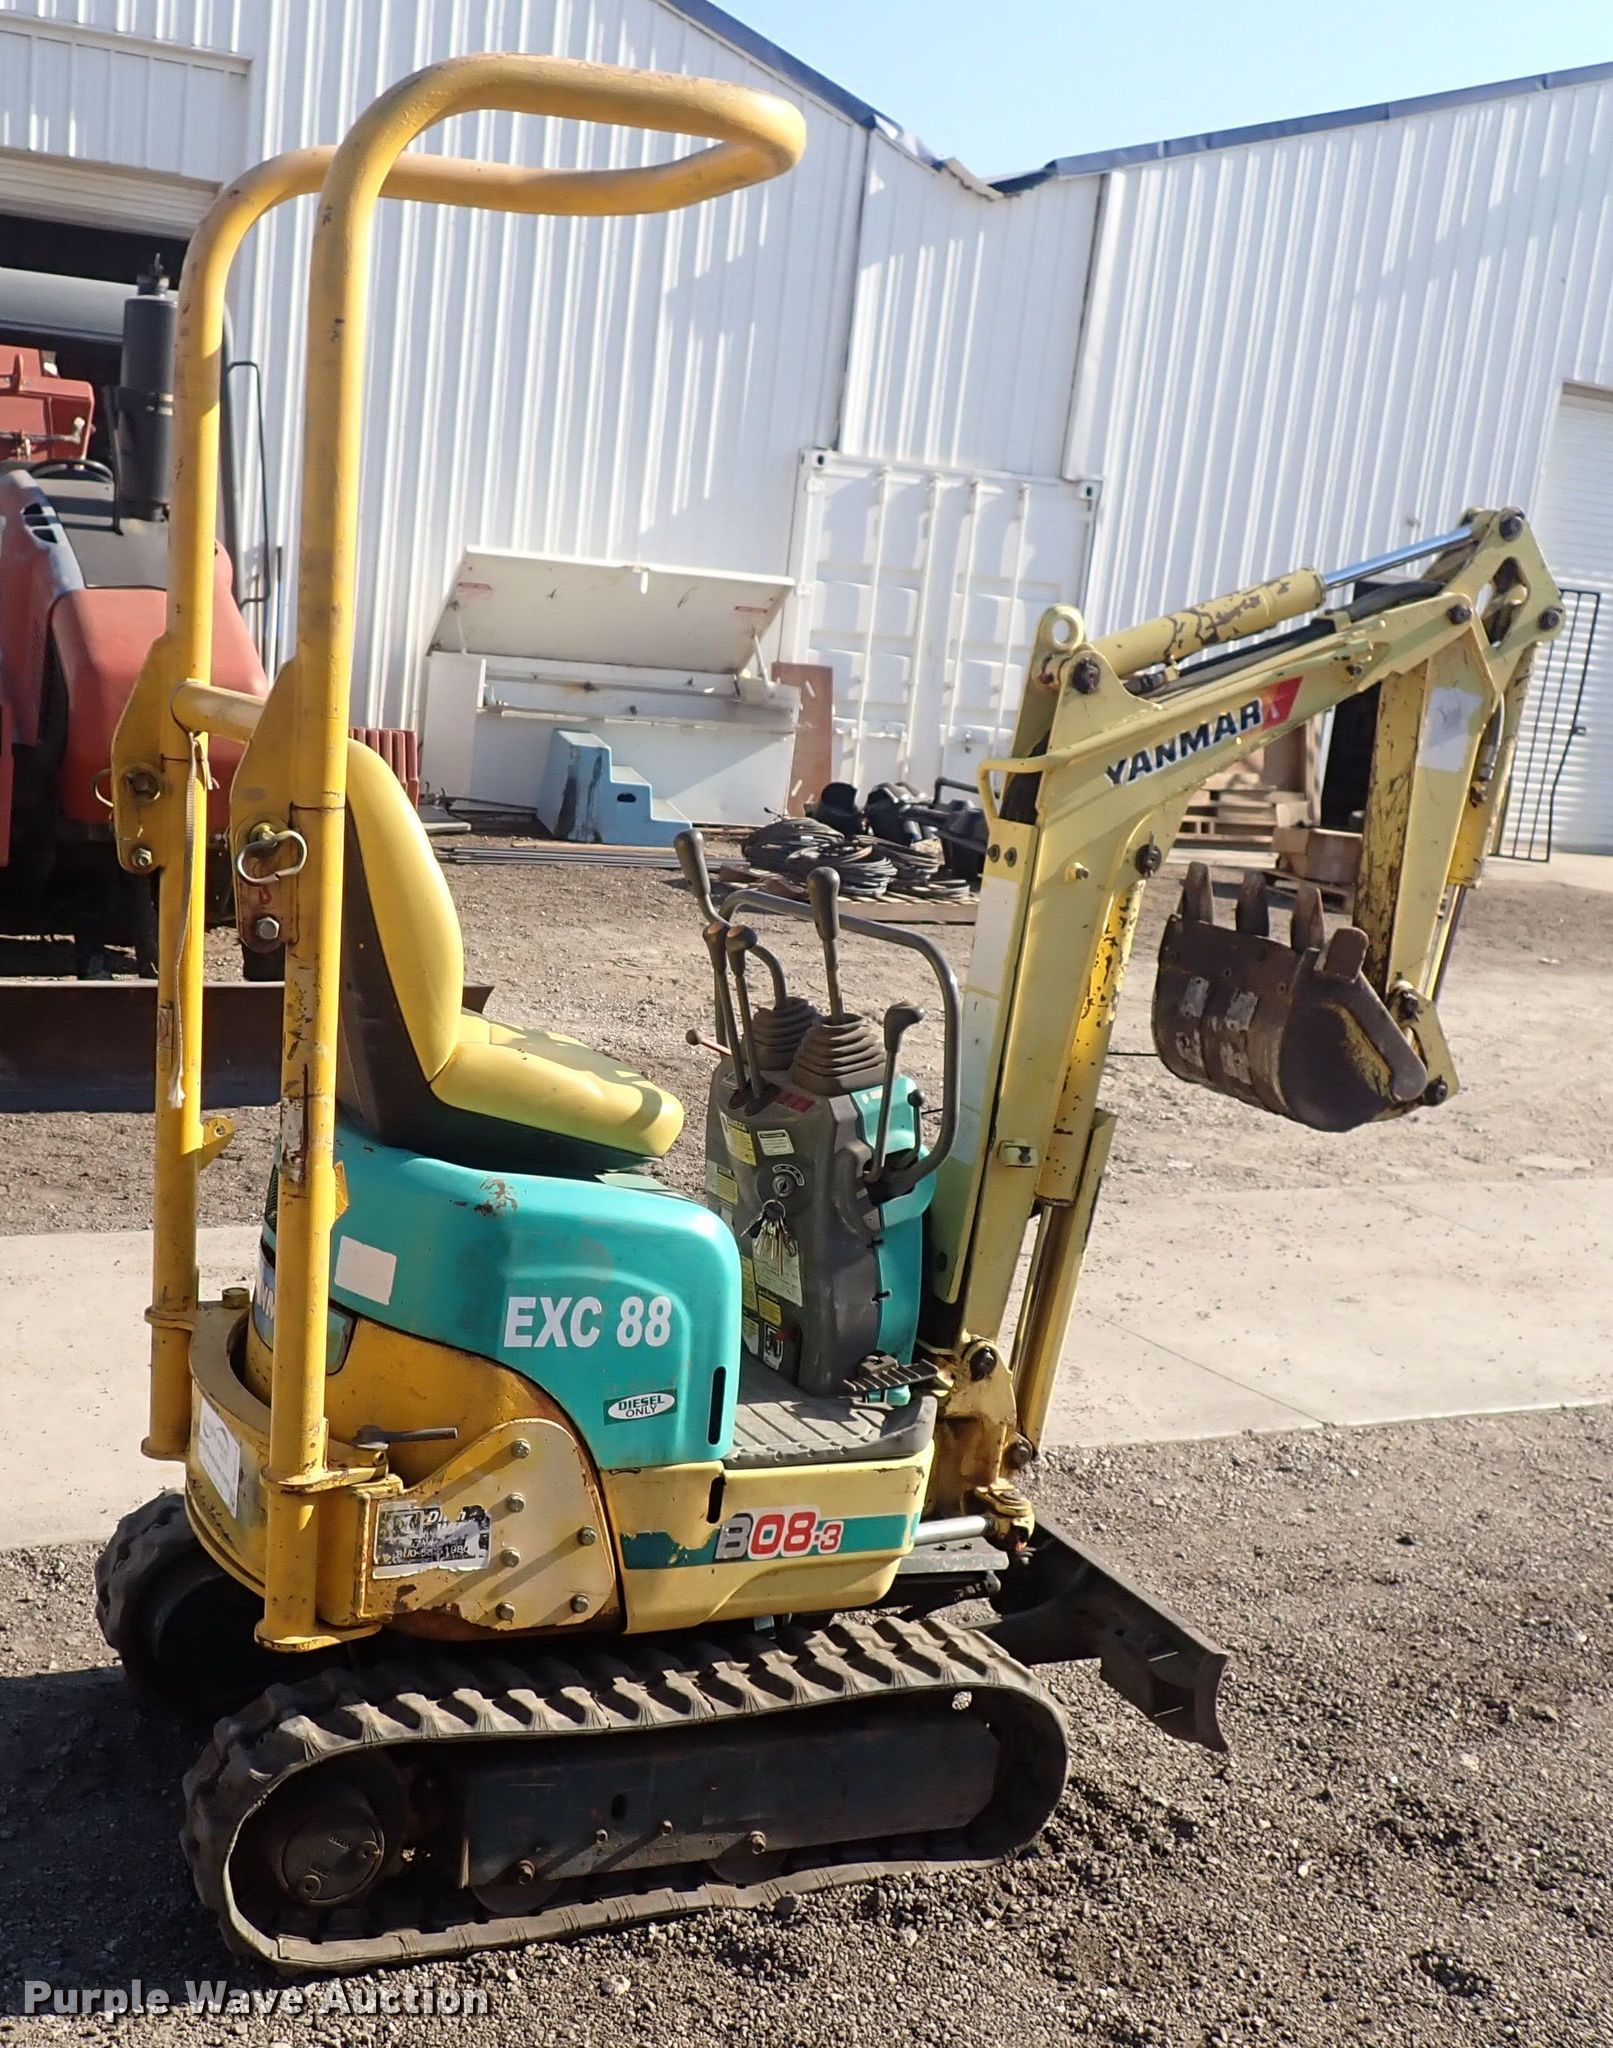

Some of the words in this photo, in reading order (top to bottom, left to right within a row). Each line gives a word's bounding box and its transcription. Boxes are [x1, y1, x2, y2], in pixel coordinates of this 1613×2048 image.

[1105, 698, 1263, 785] YANMAR
[503, 1296, 602, 1348] EXC
[616, 1296, 672, 1348] 88
[618, 1395, 665, 1411] DIESEL
[625, 1405, 657, 1418] ONLY
